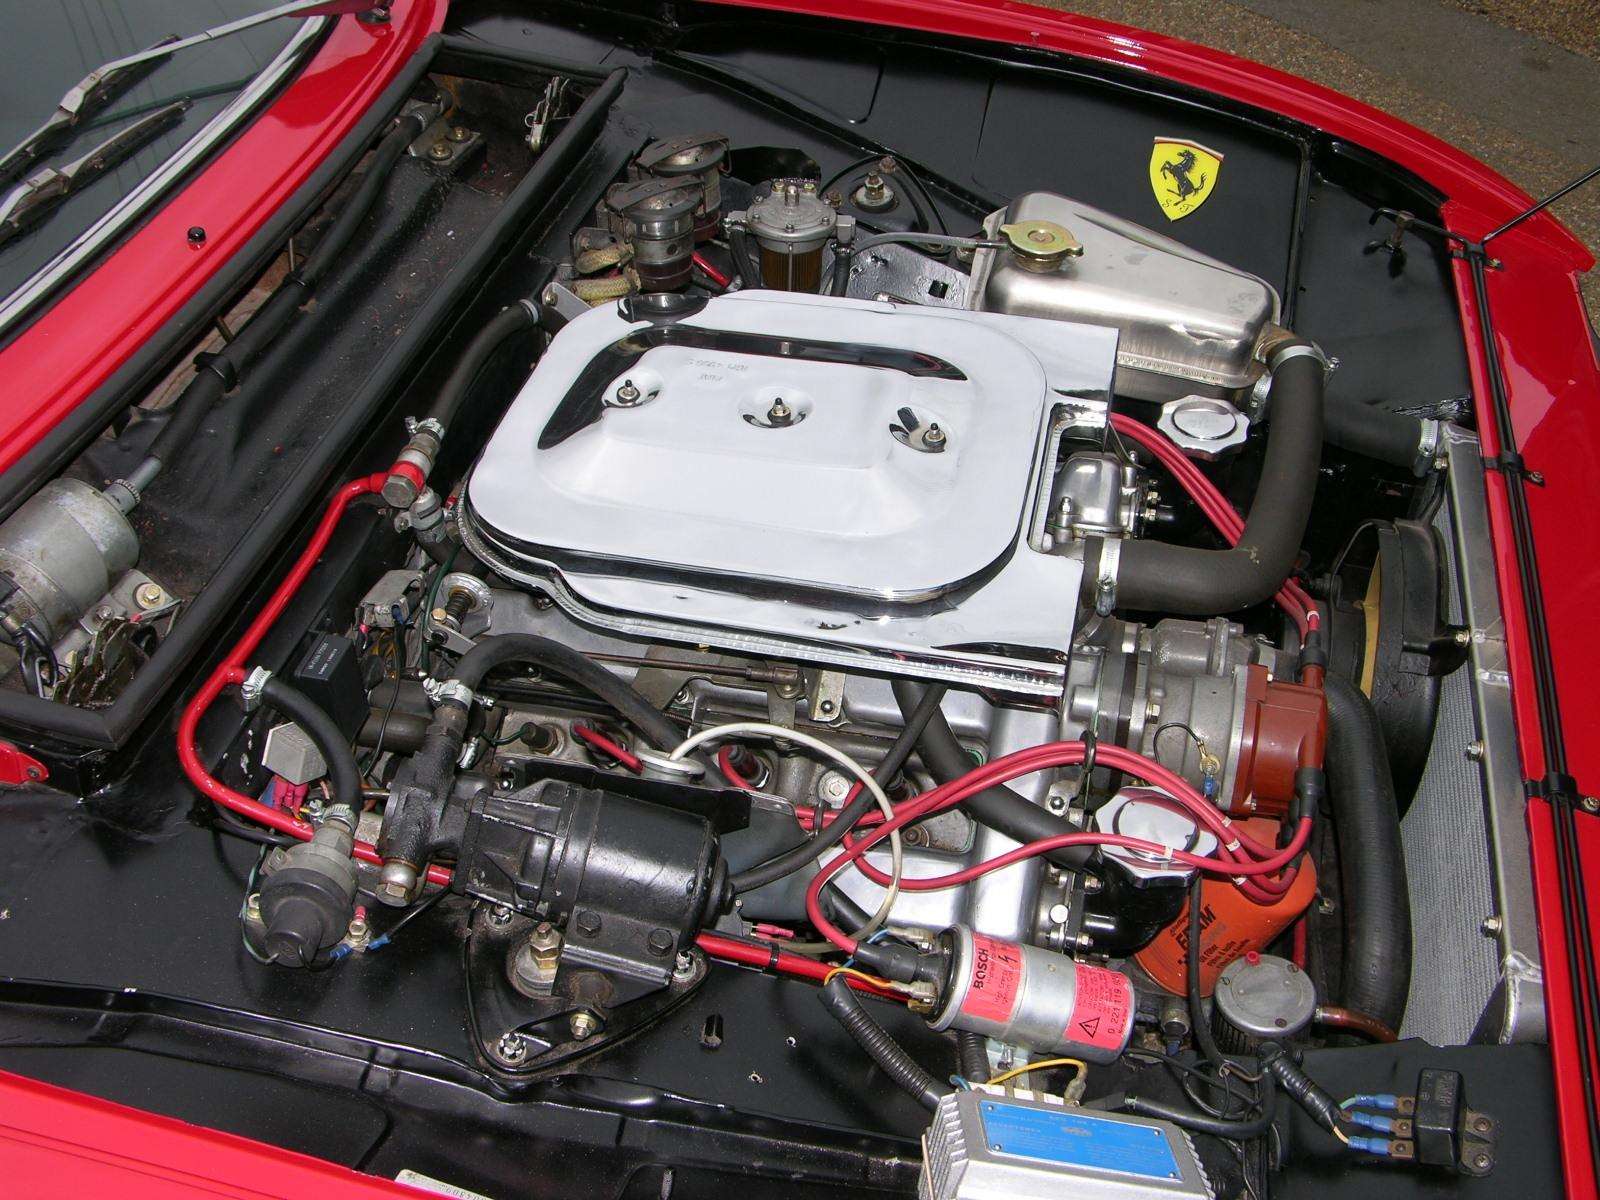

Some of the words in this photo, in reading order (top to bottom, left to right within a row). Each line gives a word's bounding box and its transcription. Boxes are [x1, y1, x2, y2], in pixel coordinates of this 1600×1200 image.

[973, 947, 989, 990] BOSCH
[1114, 988, 1122, 1004] 119
[1111, 1007, 1120, 1024] 221
